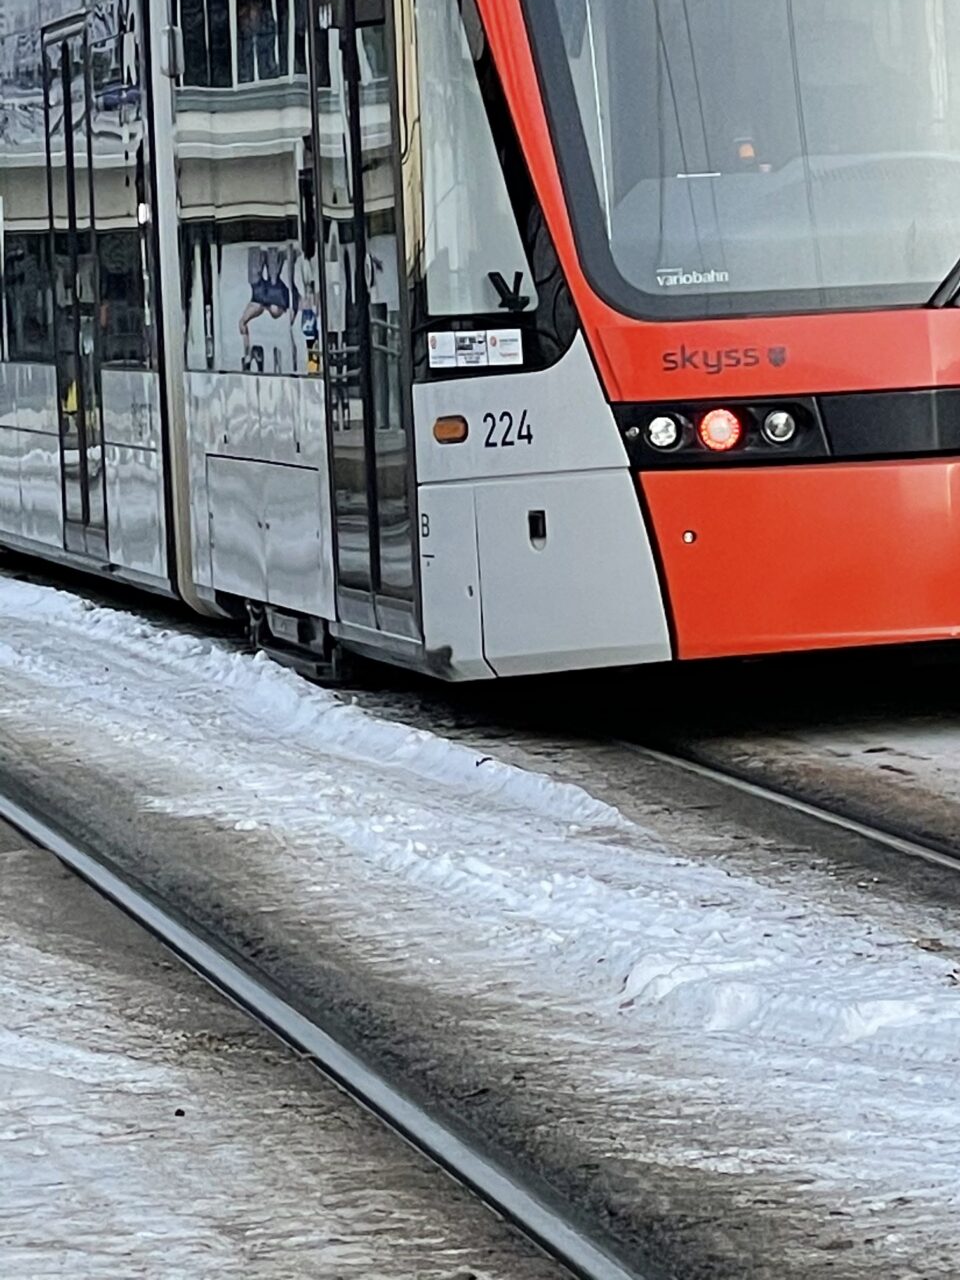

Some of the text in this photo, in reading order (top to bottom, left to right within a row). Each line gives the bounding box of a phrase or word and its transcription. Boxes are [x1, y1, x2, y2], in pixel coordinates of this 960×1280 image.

[656, 268, 730, 287] variobahn
[662, 343, 760, 375] skyss
[483, 409, 533, 448] 224
[421, 513, 430, 538] B
